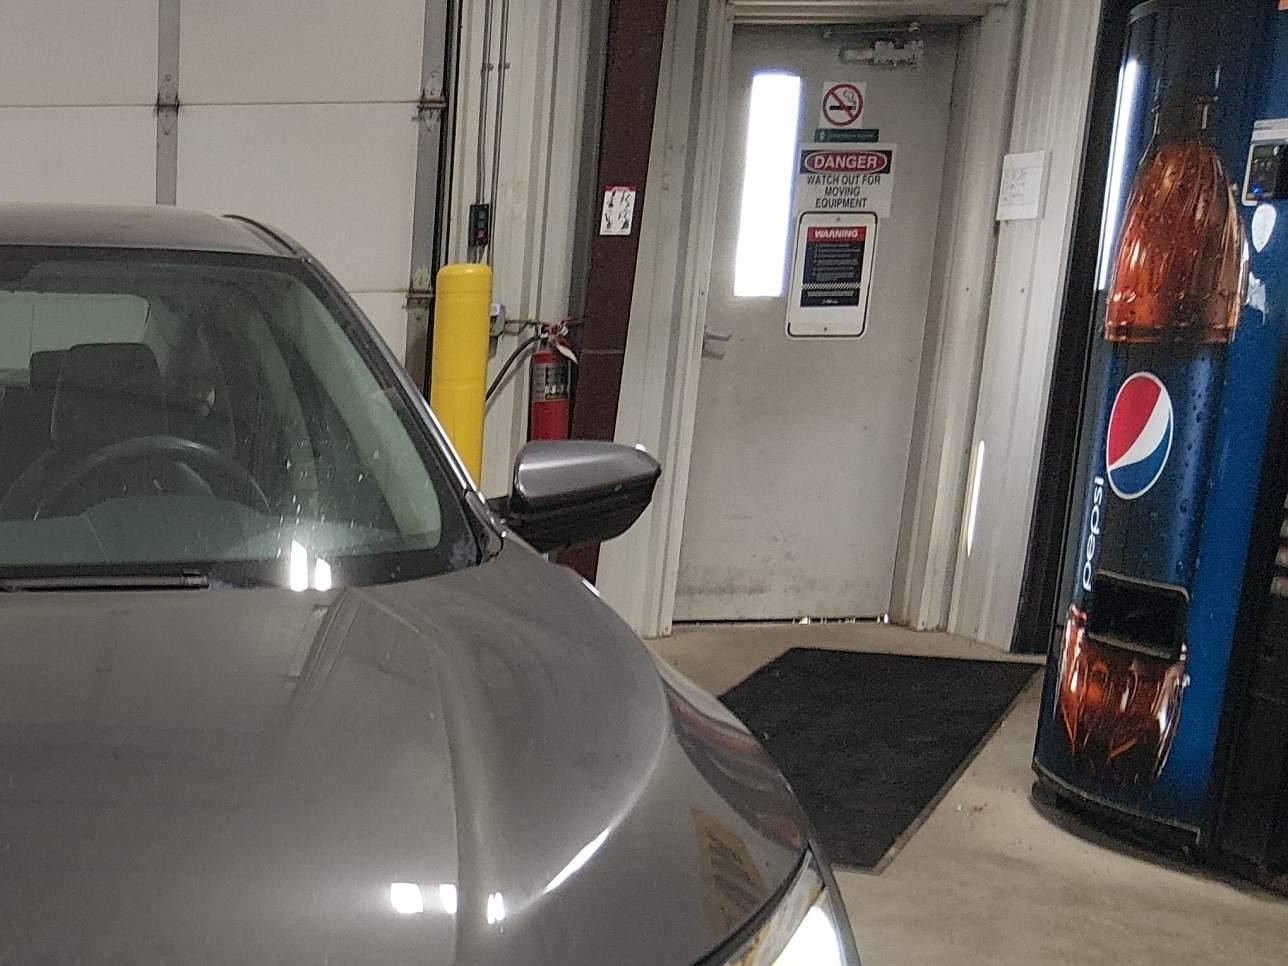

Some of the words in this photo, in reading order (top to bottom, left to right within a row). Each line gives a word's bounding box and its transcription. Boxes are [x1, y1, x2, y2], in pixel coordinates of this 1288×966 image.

[814, 155, 878, 169] DANGER
[807, 175, 839, 185] WATCH
[841, 175, 861, 185] OUT
[862, 175, 881, 185] FOR
[824, 186, 861, 197] MOVING
[815, 198, 867, 208] EQUIPMENT
[814, 229, 859, 239] WARNING
[1082, 475, 1104, 592] pepsi
